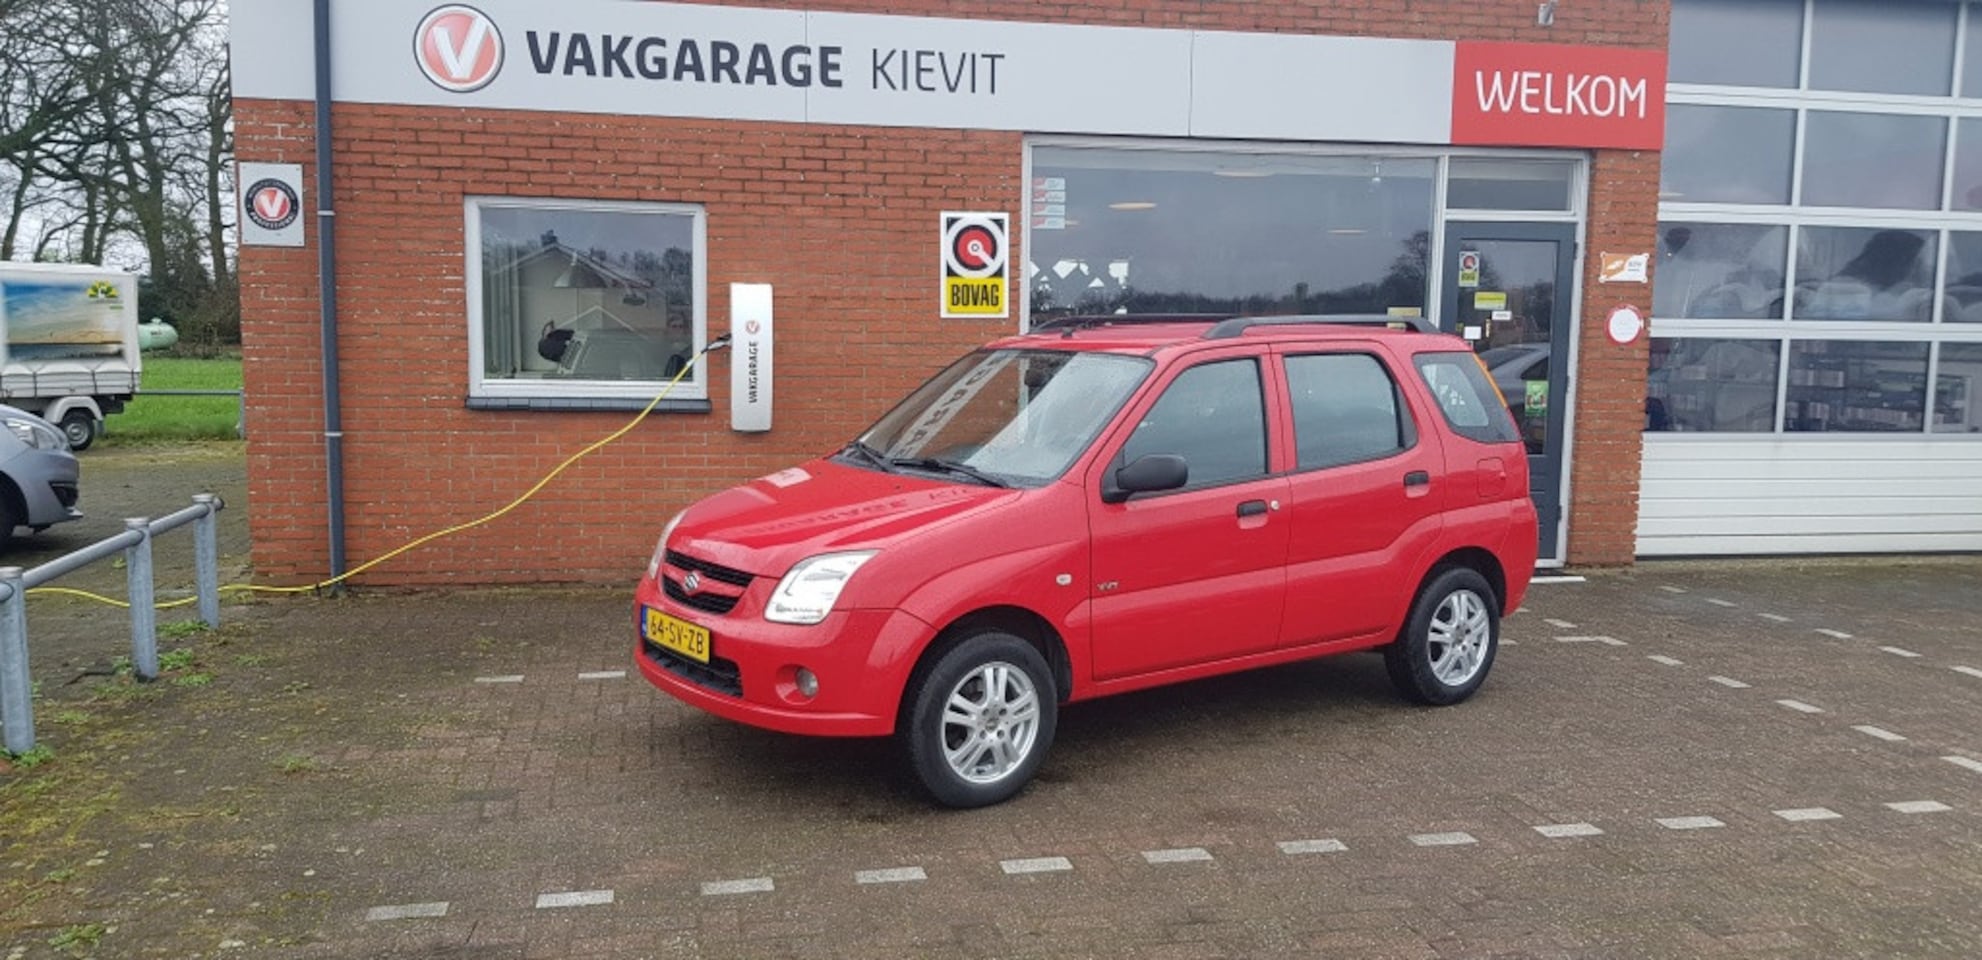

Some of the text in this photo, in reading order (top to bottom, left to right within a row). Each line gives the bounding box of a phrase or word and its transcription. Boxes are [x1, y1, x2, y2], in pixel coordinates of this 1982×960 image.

[526, 30, 1006, 95] VAKGARAGE KIEVIT
[1475, 70, 1647, 119] WELKOM
[950, 284, 1000, 307] BOVAG
[748, 340, 759, 404] VAKGARAGE
[650, 614, 704, 656] 64-SV-ZB
